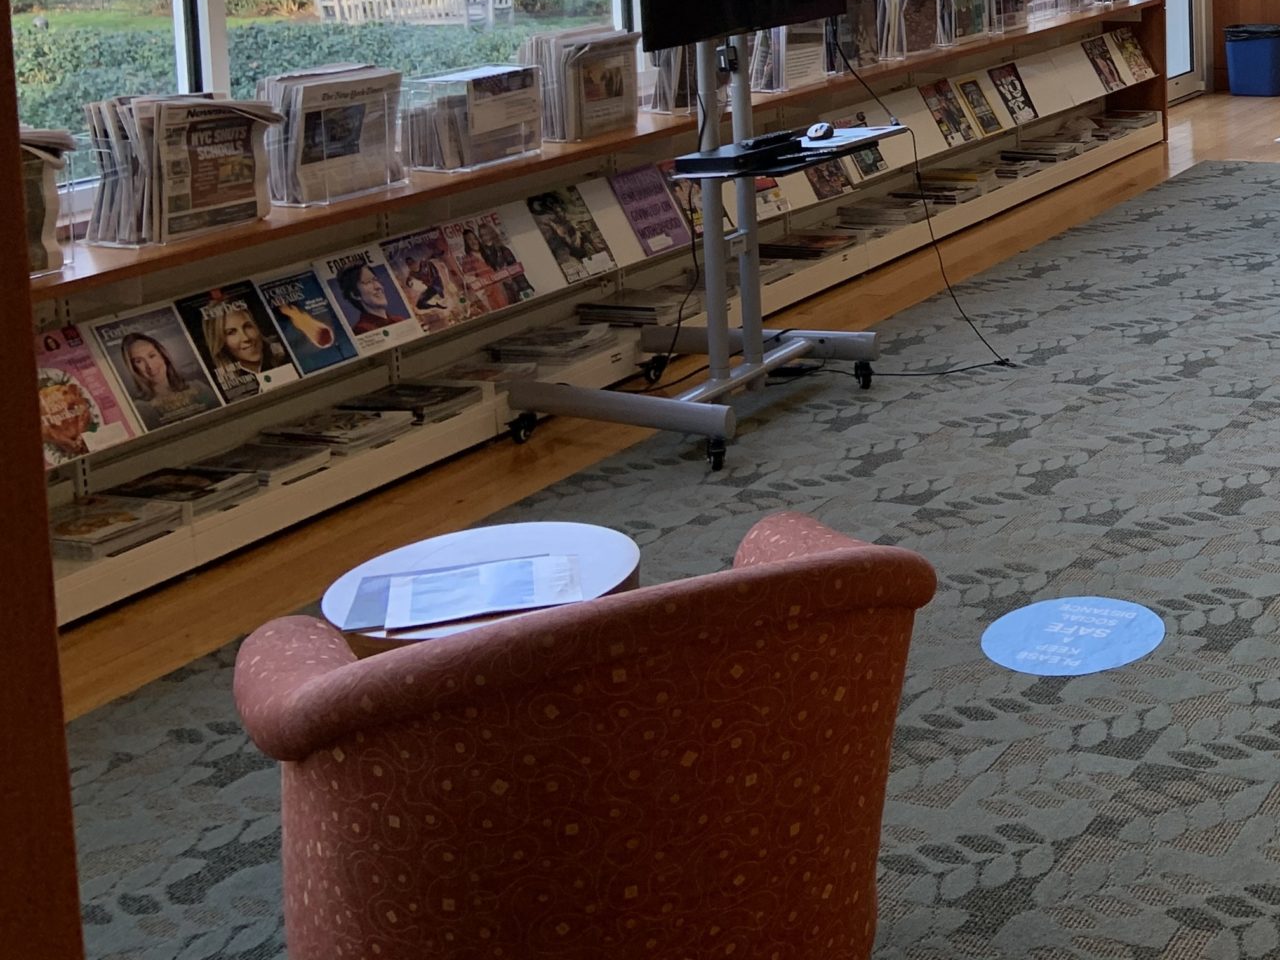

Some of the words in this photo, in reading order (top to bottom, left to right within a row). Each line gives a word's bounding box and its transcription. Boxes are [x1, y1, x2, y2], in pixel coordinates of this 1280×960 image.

[213, 126, 247, 142] SHUTS
[196, 140, 244, 160] SCHOOLS
[326, 249, 374, 275] FORTUNE
[263, 280, 304, 299] FOREIGN
[269, 291, 305, 308] AFFAIRS
[199, 299, 248, 321] Forbes
[1059, 603, 1137, 619] DISTANCE
[1061, 613, 1118, 627] SOCIAL
[1043, 622, 1112, 638] SAFE
[1035, 643, 1081, 655] KEEP
[1016, 651, 1082, 667] PLEASE
